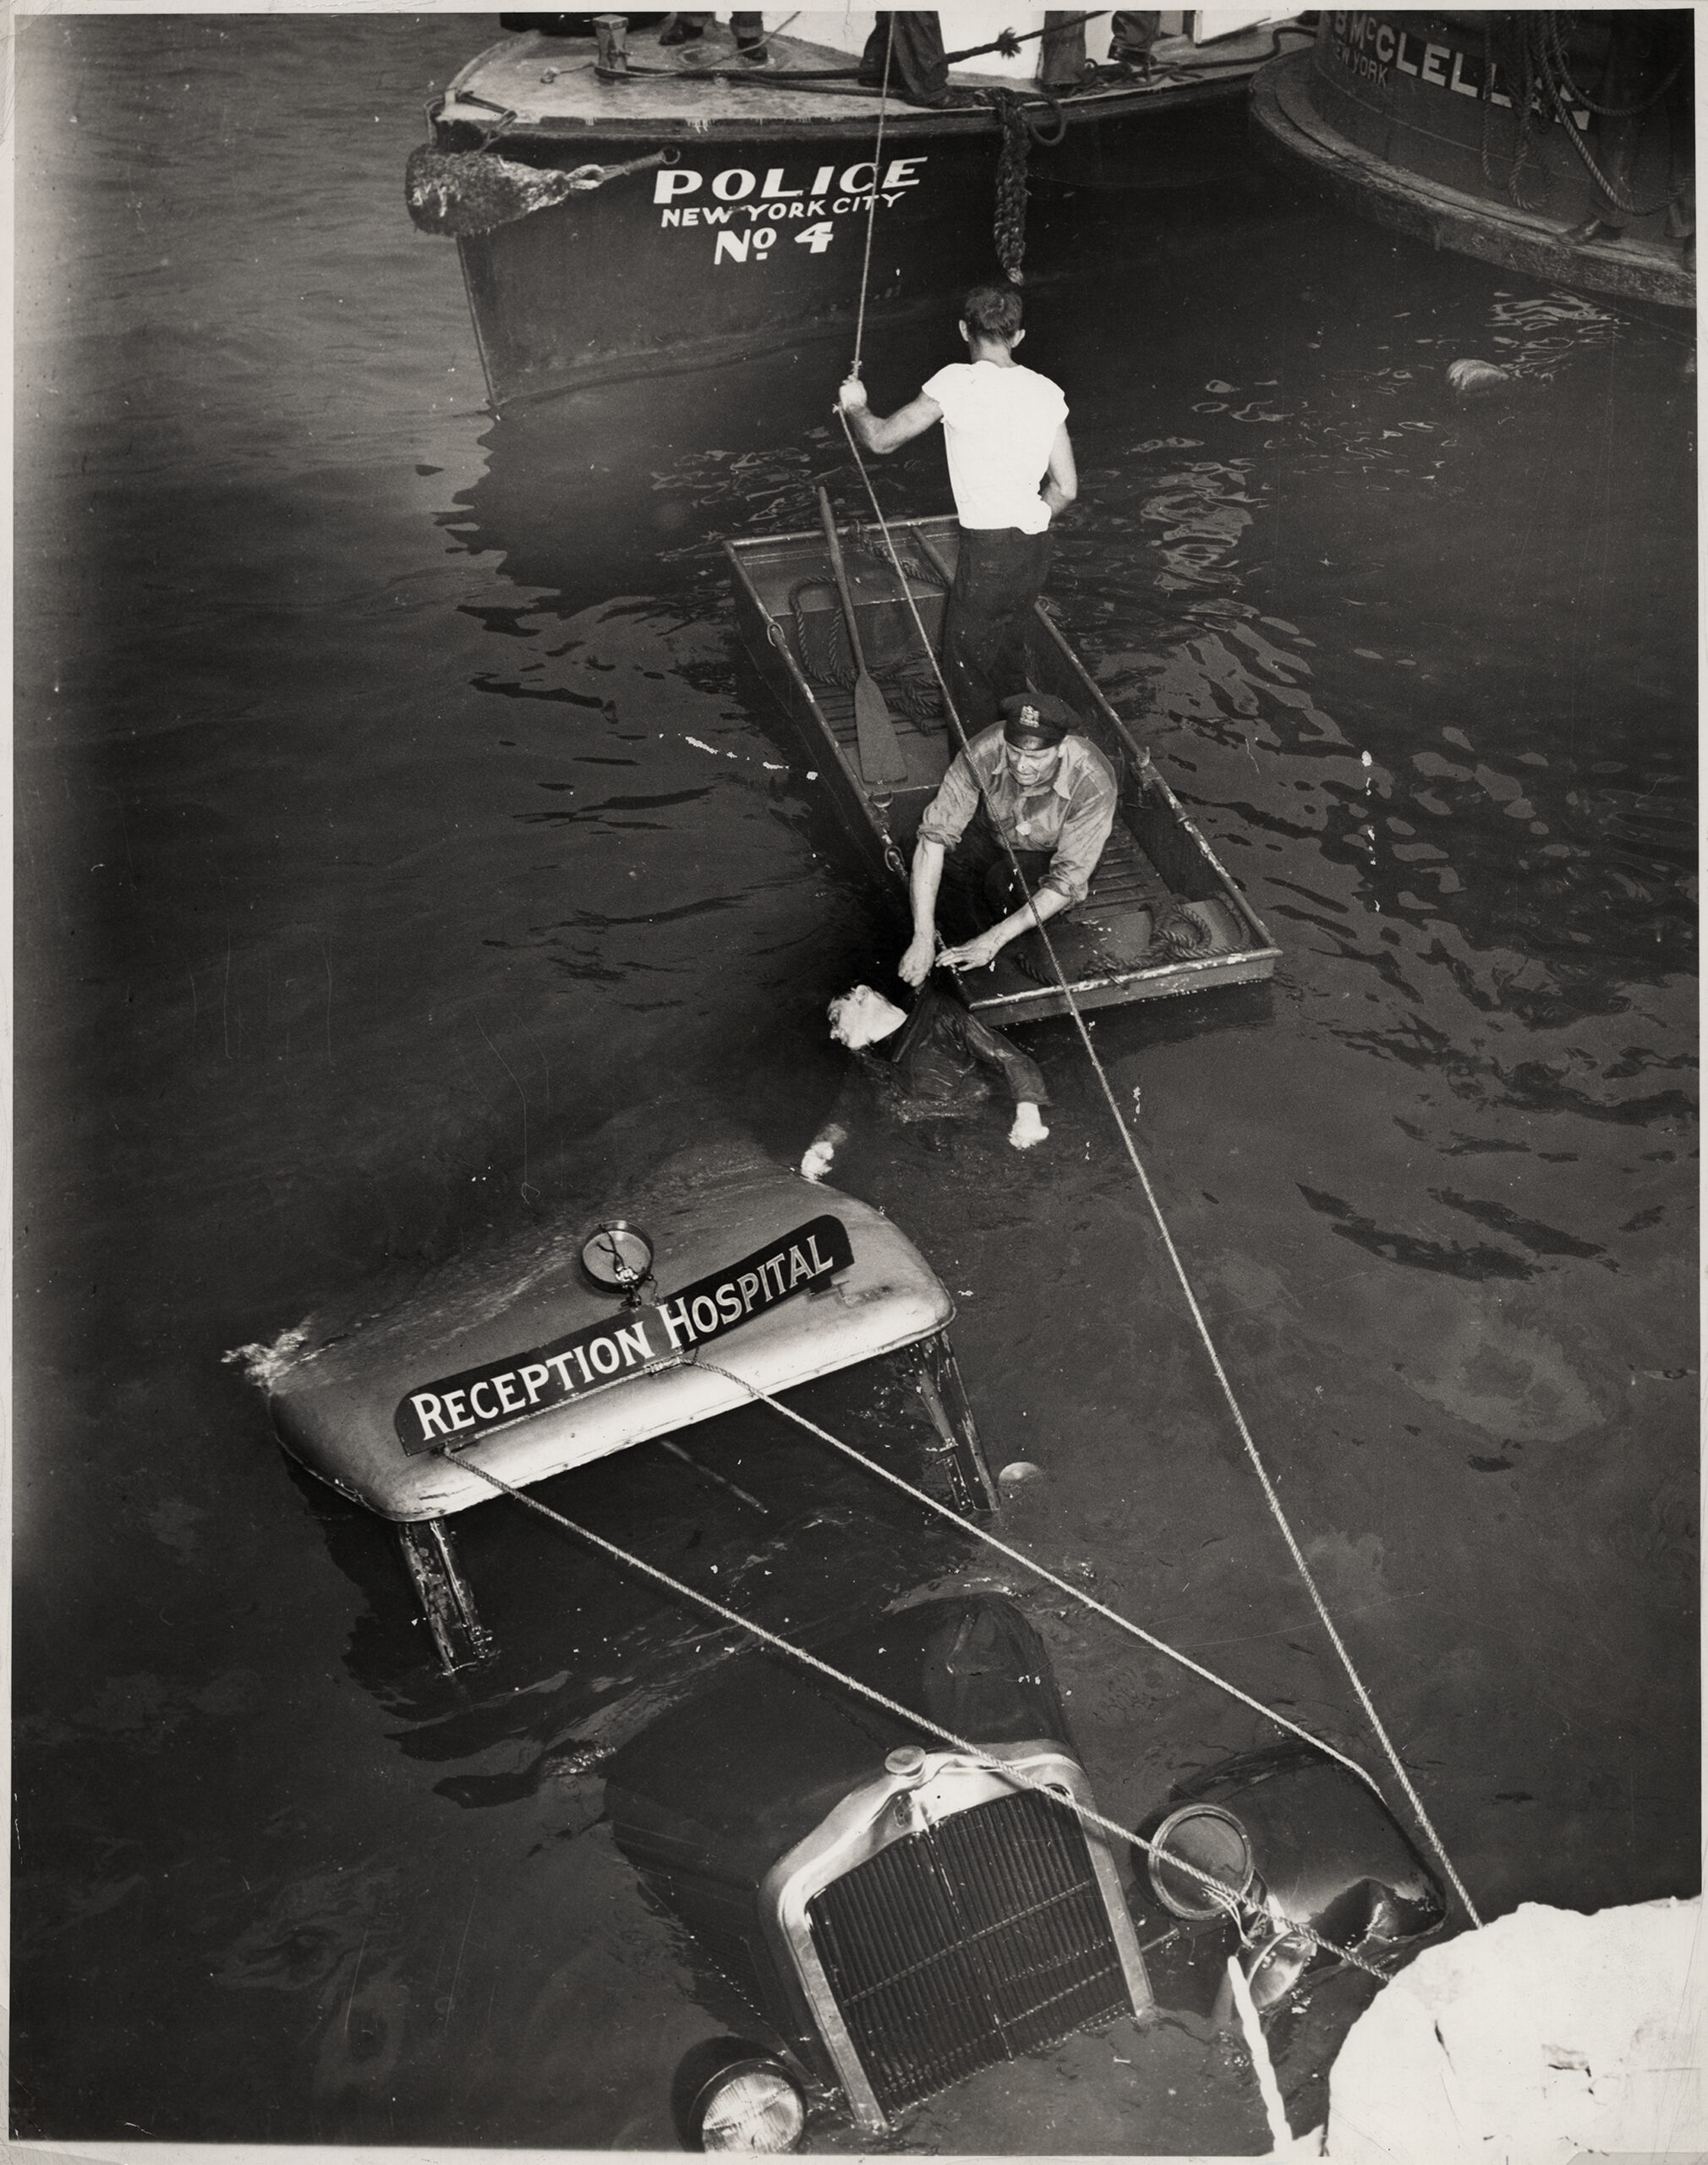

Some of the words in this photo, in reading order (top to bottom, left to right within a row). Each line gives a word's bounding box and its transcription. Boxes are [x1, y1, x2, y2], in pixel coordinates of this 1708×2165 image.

[1353, 51, 1388, 89] YORK
[653, 156, 928, 204] POLICE
[660, 206, 731, 227] NEW
[747, 200, 826, 222] YORK
[832, 191, 906, 215] CITY
[794, 221, 834, 254] 4
[411, 1321, 655, 1440] RECEPTION
[657, 1235, 834, 1349] HOSPITAL
